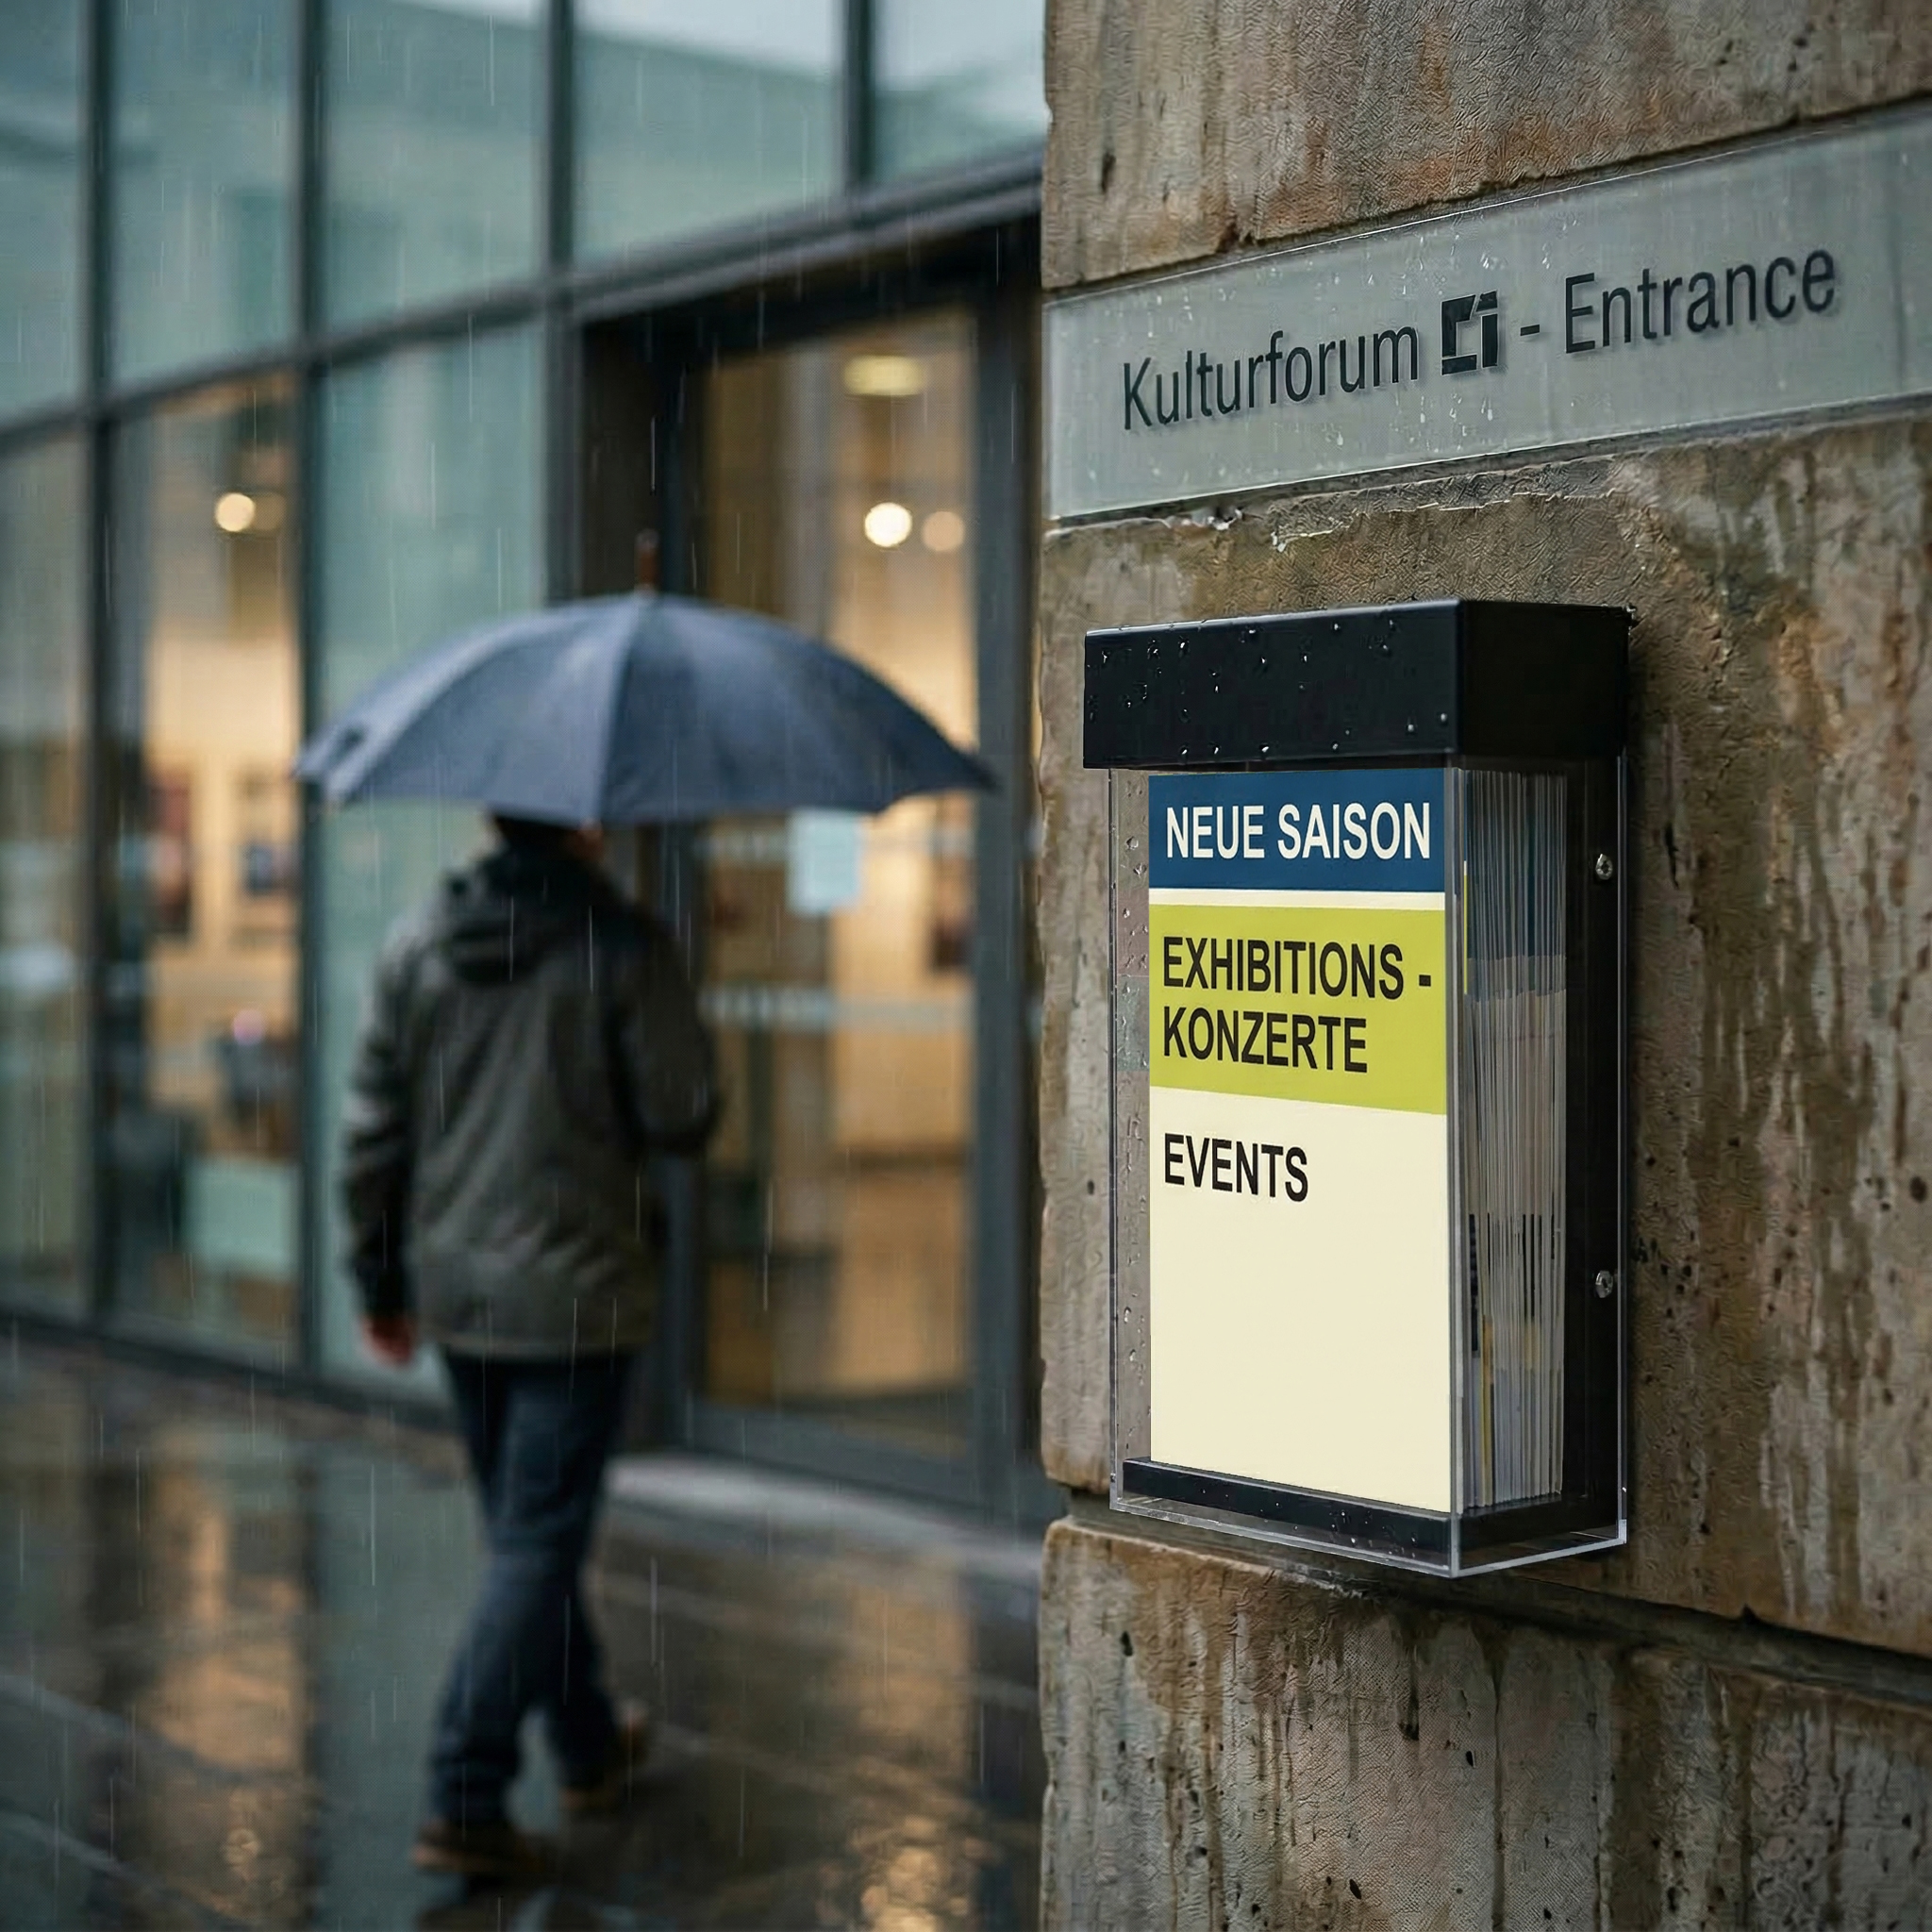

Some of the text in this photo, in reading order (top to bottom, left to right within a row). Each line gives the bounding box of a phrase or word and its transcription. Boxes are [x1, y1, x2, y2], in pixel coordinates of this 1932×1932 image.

[1123, 325, 1419, 430] Kulturforum
[1565, 248, 1835, 354] Entrance
[1166, 801, 1431, 860] NEUE SAISON
[1163, 936, 1404, 1000] EXHIBITIONS
[1163, 1006, 1368, 1074] KONZERTE
[1164, 1132, 1308, 1203] EVENTS
